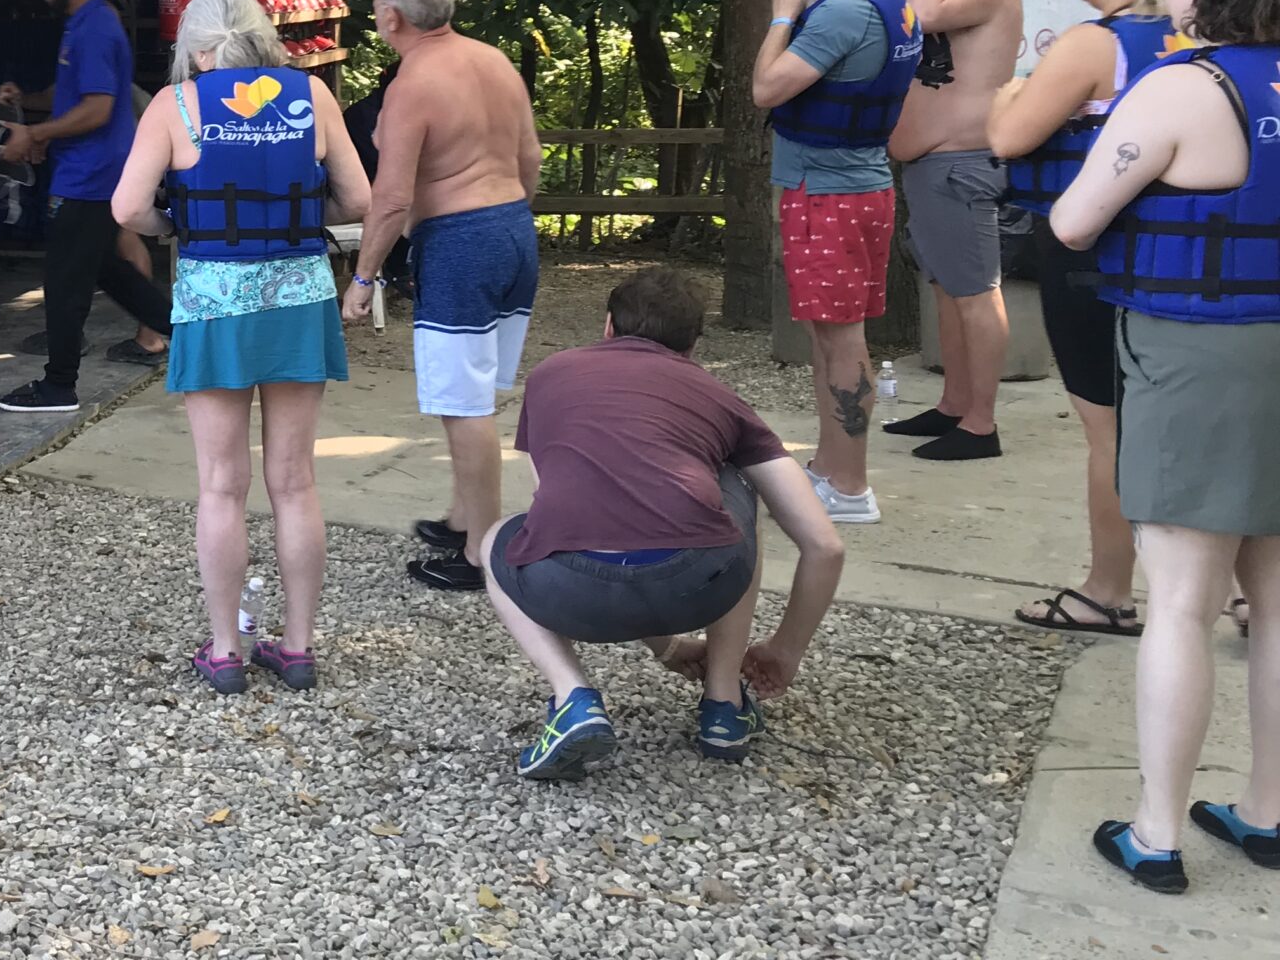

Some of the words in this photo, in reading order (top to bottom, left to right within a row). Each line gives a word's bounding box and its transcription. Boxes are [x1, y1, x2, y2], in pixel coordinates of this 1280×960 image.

[202, 123, 304, 147] Damajagua
[224, 120, 260, 132] Saltos
[261, 121, 274, 132] de
[275, 121, 287, 132] la
